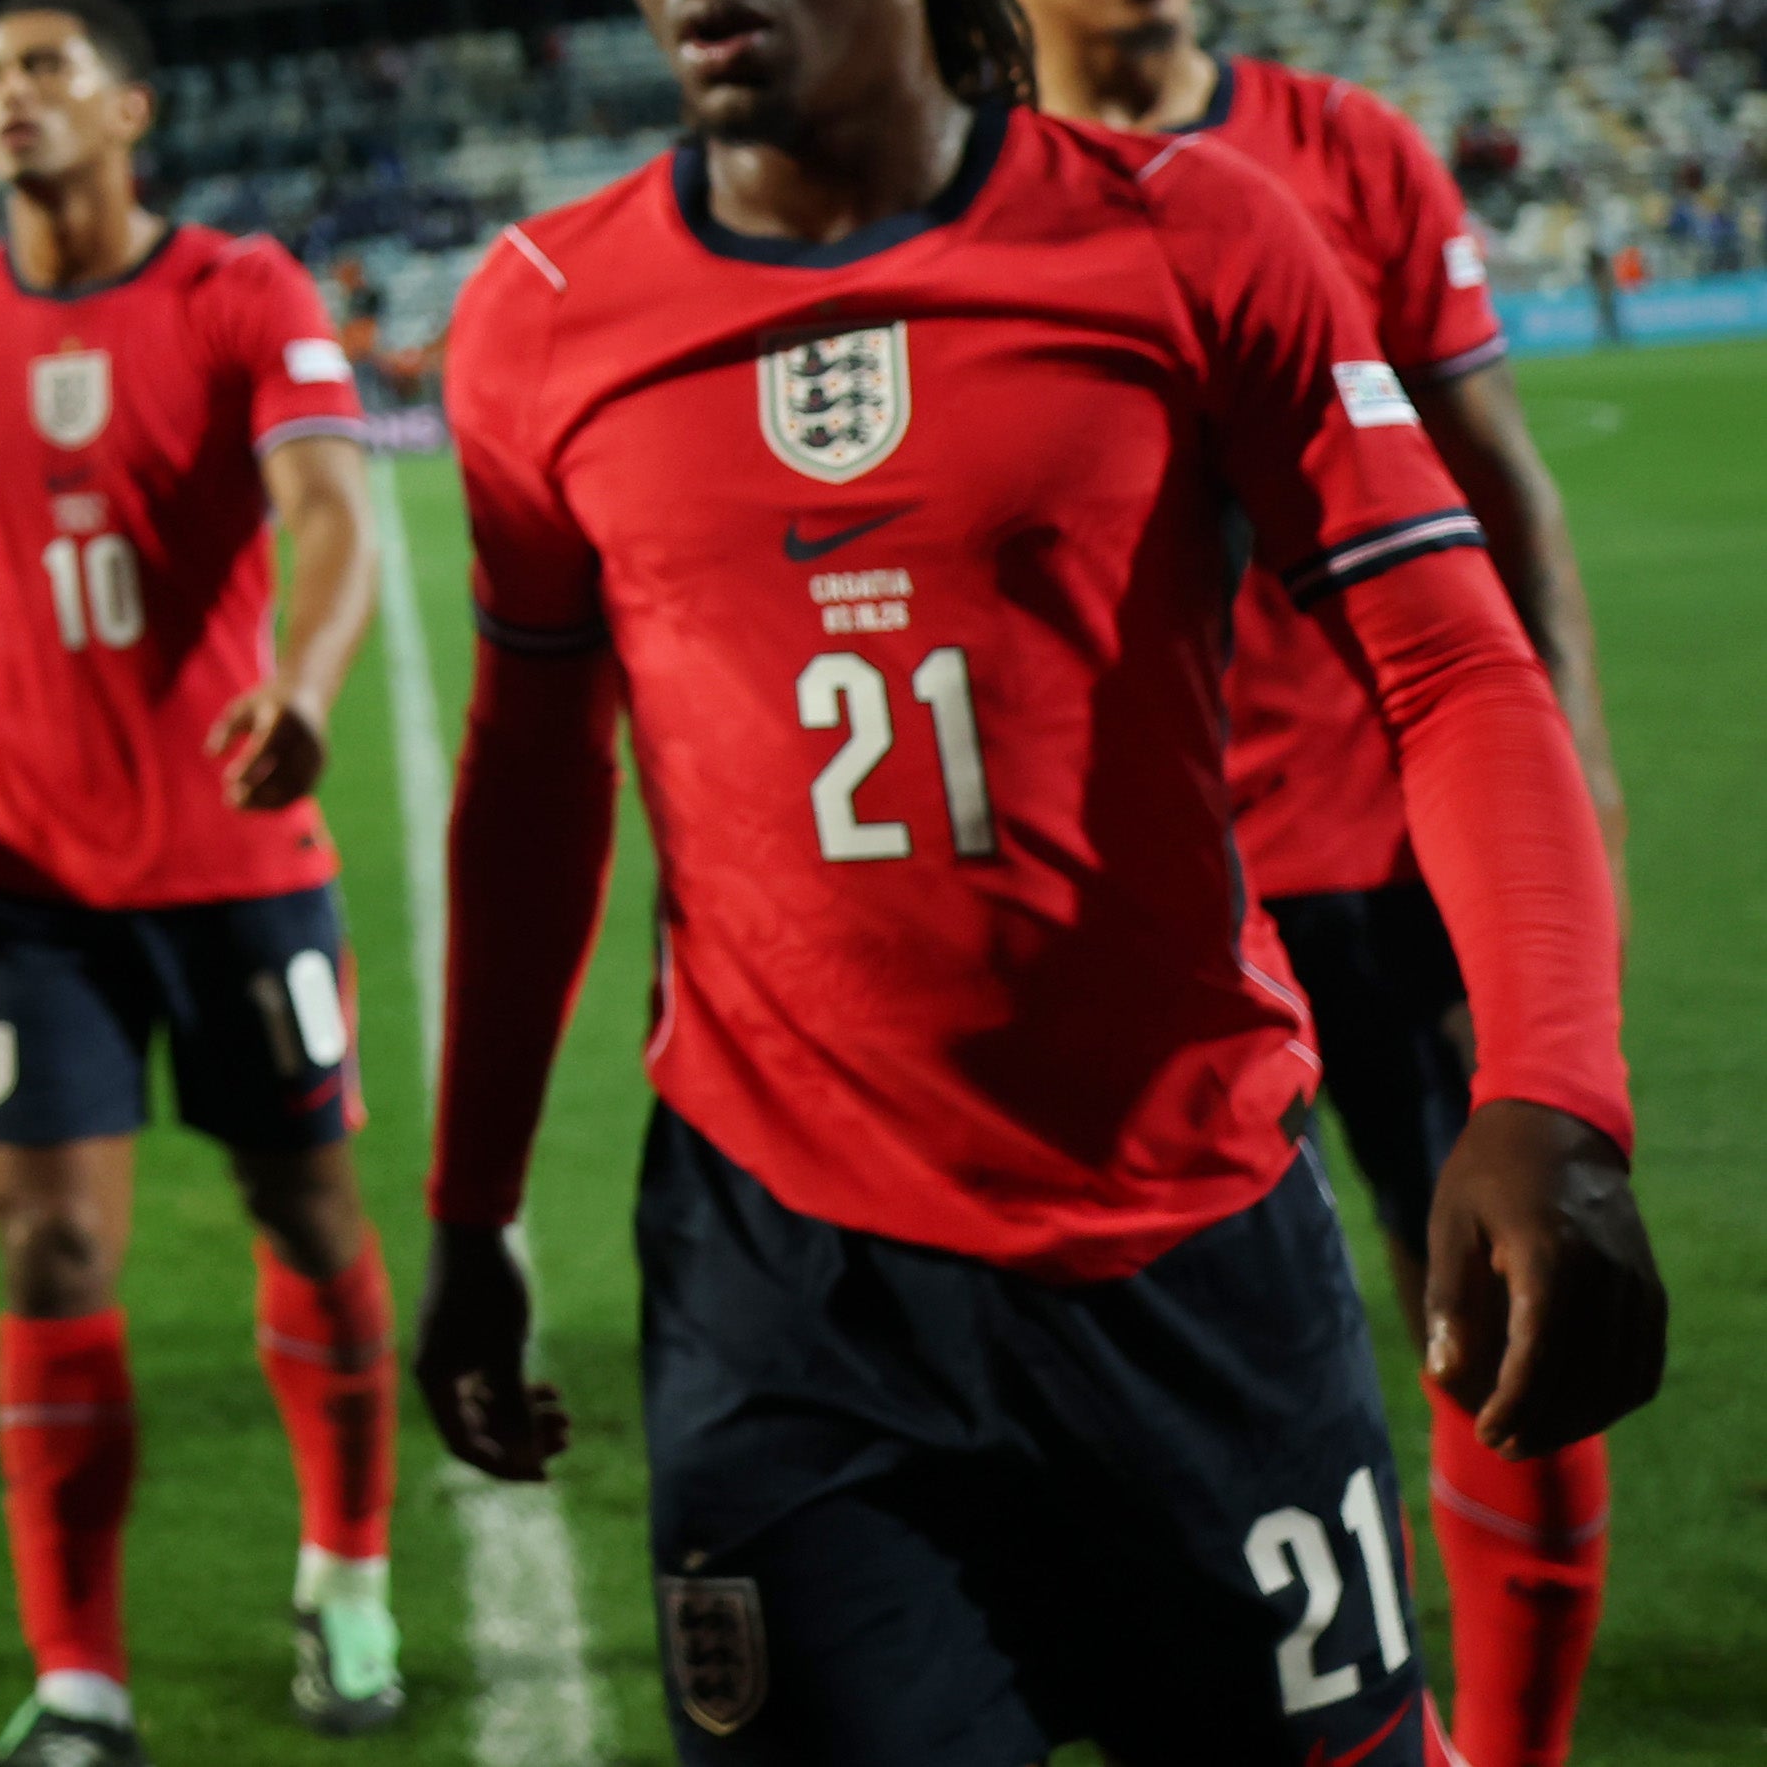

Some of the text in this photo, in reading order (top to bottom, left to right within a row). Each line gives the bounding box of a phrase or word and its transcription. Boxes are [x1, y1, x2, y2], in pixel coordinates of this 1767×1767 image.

[41, 533, 145, 652] 10
[795, 646, 995, 863] 21
[249, 947, 348, 1078] 10
[1243, 1464, 1412, 1716] 21
